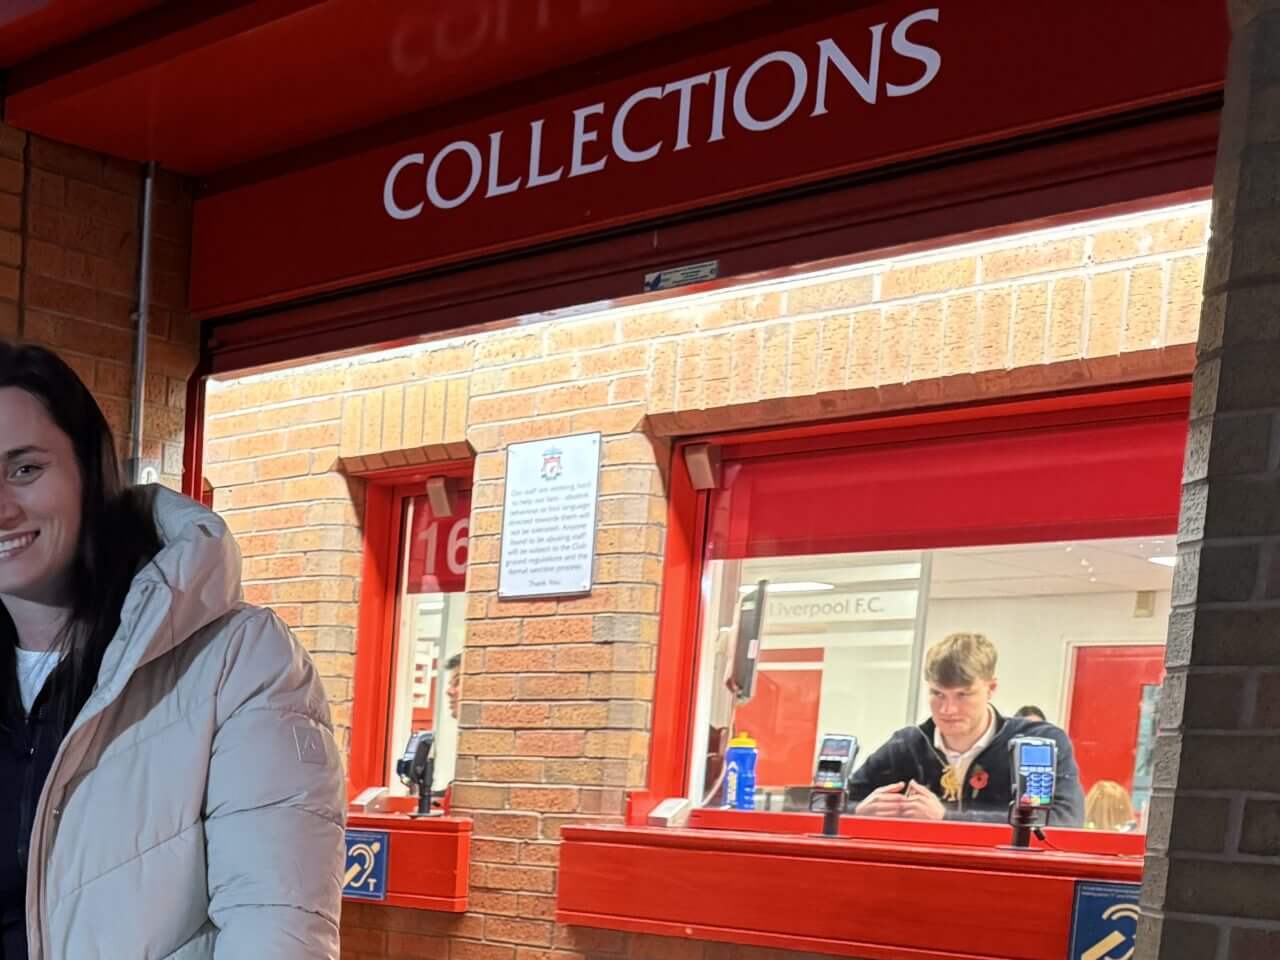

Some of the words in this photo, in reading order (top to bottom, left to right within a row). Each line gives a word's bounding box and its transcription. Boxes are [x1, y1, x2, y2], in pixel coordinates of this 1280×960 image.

[383, 8, 942, 220] COLLECTIONS
[417, 517, 469, 575] 16
[771, 598, 849, 618] Liverpool
[855, 597, 885, 614] F.C.
